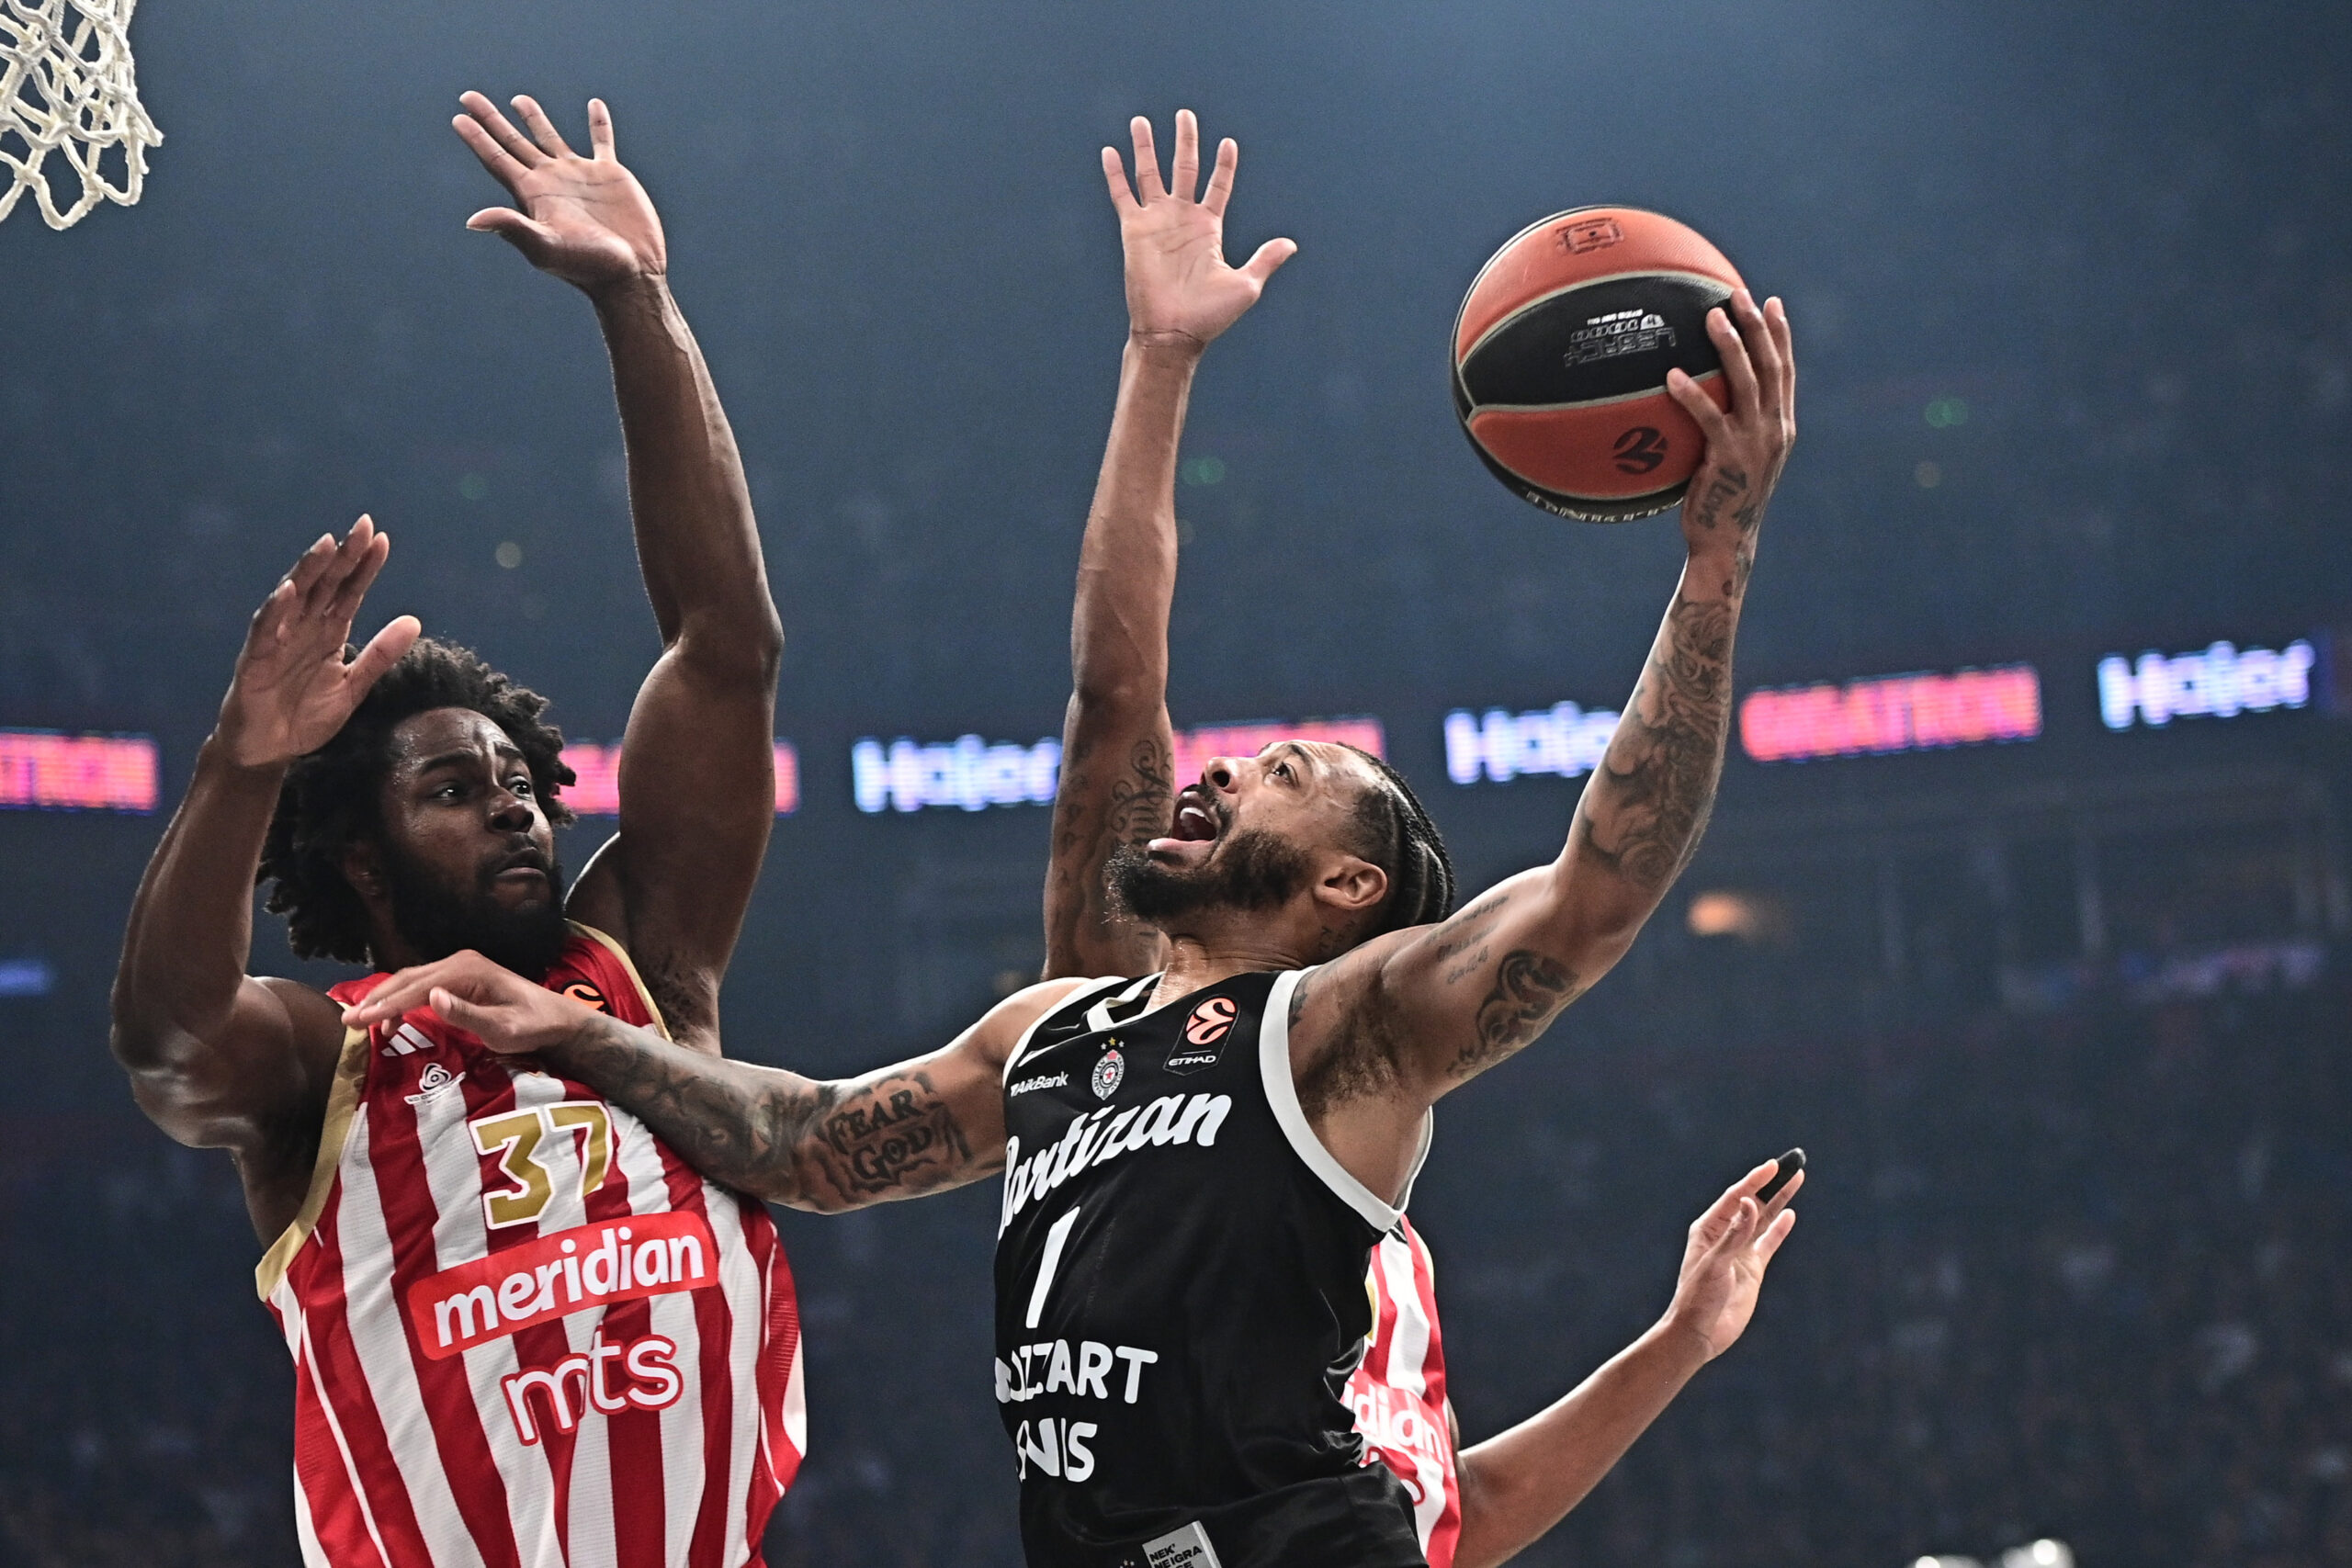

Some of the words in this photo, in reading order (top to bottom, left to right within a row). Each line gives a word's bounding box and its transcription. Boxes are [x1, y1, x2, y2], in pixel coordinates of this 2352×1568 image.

[1444, 701, 1621, 784] Haie
[1018, 1071, 1069, 1093] AikBank
[1168, 1055, 1216, 1066] ETIHAD
[826, 1089, 925, 1155] FEAR
[853, 1126, 933, 1179] GOD
[469, 1100, 614, 1230] 37
[433, 1226, 705, 1348] meridian
[1025, 1206, 1080, 1328] 1
[503, 1328, 683, 1443] mts
